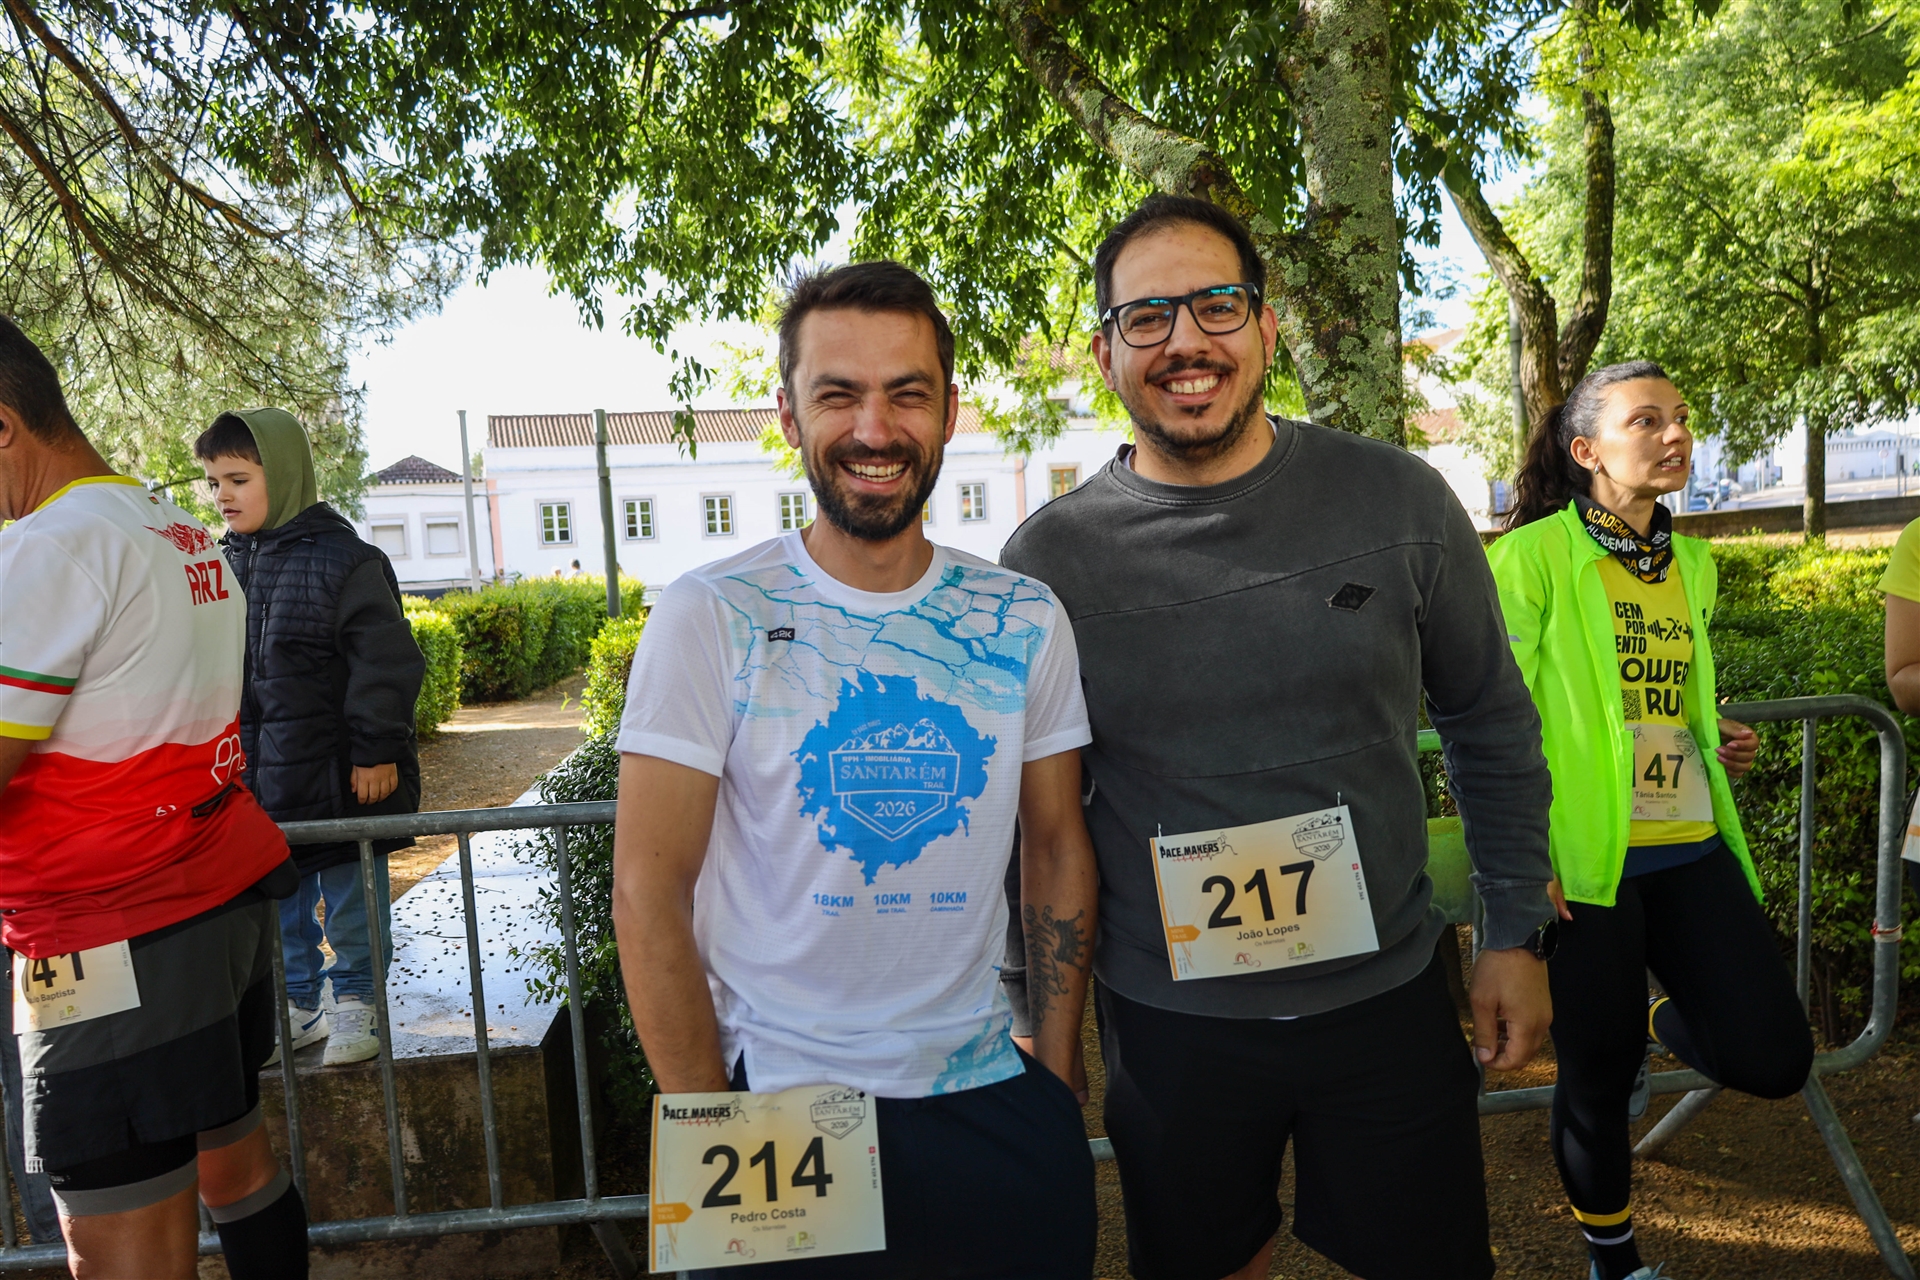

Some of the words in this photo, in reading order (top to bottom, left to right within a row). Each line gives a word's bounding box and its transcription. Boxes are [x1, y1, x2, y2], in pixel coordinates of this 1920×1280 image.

[184, 559, 229, 606] ARZ
[1614, 601, 1644, 620] CEM
[1625, 620, 1646, 635] POR
[1615, 634, 1647, 654] ENTO
[1619, 657, 1690, 687] OWER
[1645, 687, 1684, 717] RU
[842, 755, 859, 763] RPH
[840, 762, 947, 780] SANTARÉM
[923, 781, 945, 789] TRAIL
[1655, 791, 1677, 799] Santos
[874, 800, 916, 817] 2026
[812, 893, 854, 907] 18KM
[873, 893, 912, 906] 10KM
[929, 891, 967, 904] 10KM
[1201, 859, 1315, 929] 217
[821, 909, 840, 917] TRAIL
[1236, 929, 1263, 941] João
[1266, 924, 1300, 936] Lopes
[25, 951, 85, 992] 41
[40, 989, 76, 1001] Baptista
[701, 1136, 833, 1209] 214
[730, 1211, 767, 1223] Pedro
[771, 1207, 806, 1219] Costa
